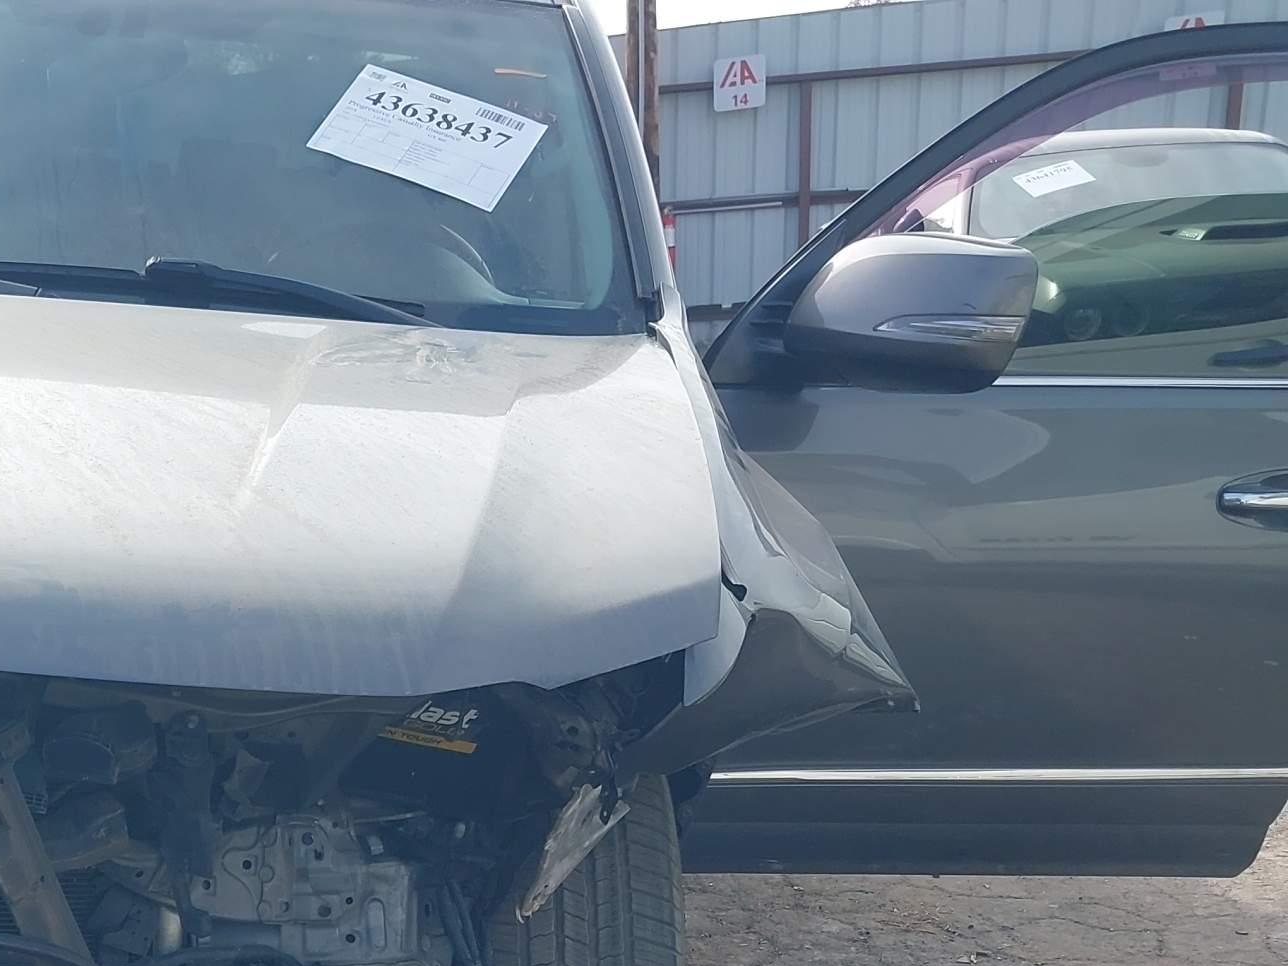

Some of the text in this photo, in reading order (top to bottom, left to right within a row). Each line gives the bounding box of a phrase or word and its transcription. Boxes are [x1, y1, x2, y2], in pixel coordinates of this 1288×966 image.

[732, 92, 749, 108] 14
[365, 90, 513, 149] 43638437
[406, 700, 480, 729] last
